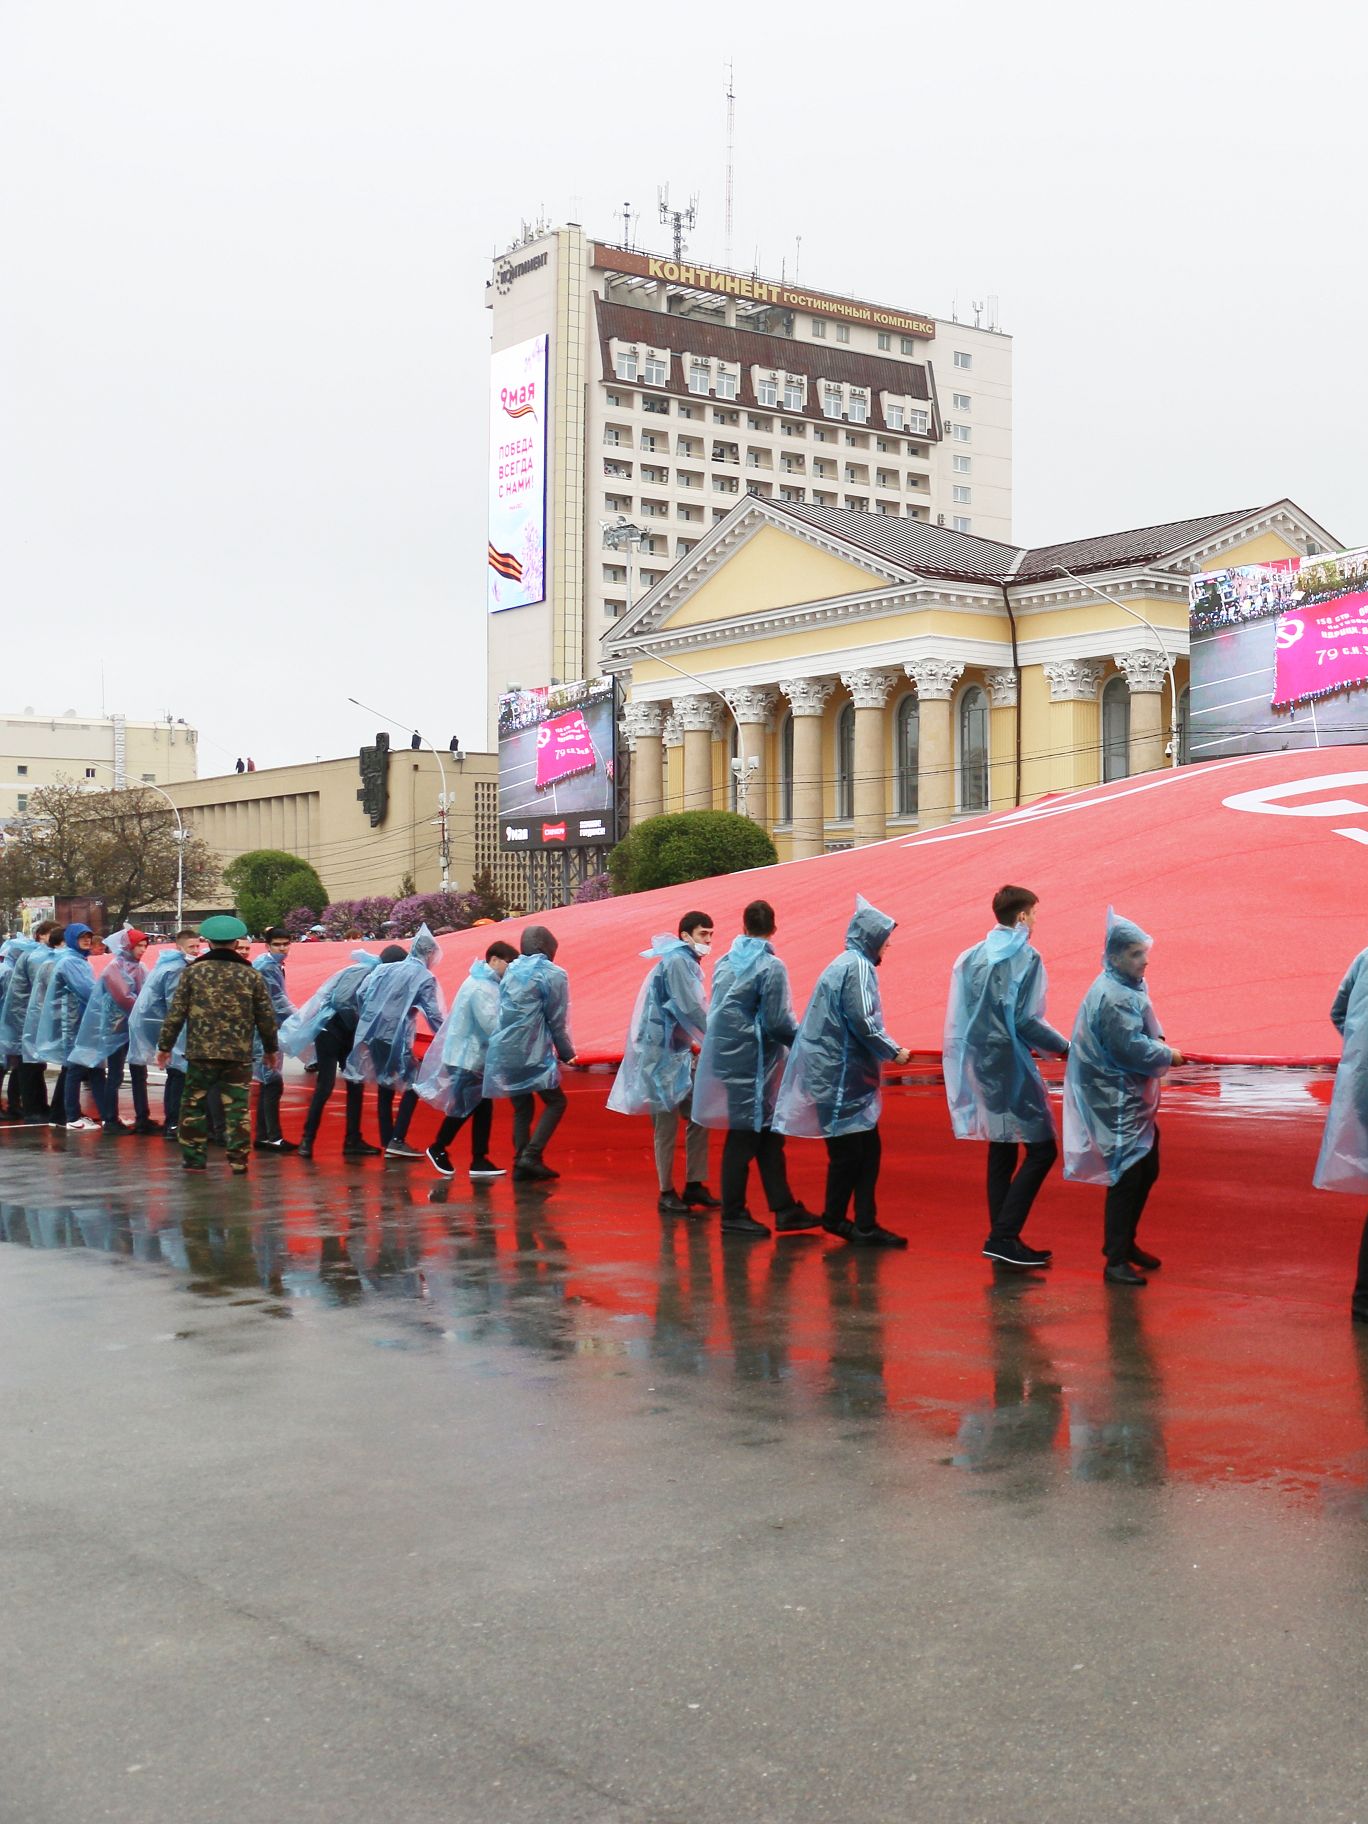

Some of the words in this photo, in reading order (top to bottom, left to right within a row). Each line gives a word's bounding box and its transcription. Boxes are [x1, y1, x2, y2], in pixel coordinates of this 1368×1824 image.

[648, 258, 781, 303] КОНТИНЕНТ
[783, 291, 872, 321] ГОСТИНИЧНЫЙ
[873, 312, 934, 335] КОМПЛЕКС
[499, 437, 534, 460] ПОБЕДА
[499, 457, 534, 480] ВСЕГДА
[506, 475, 534, 496] НАМИ!
[1315, 648, 1338, 665] 79
